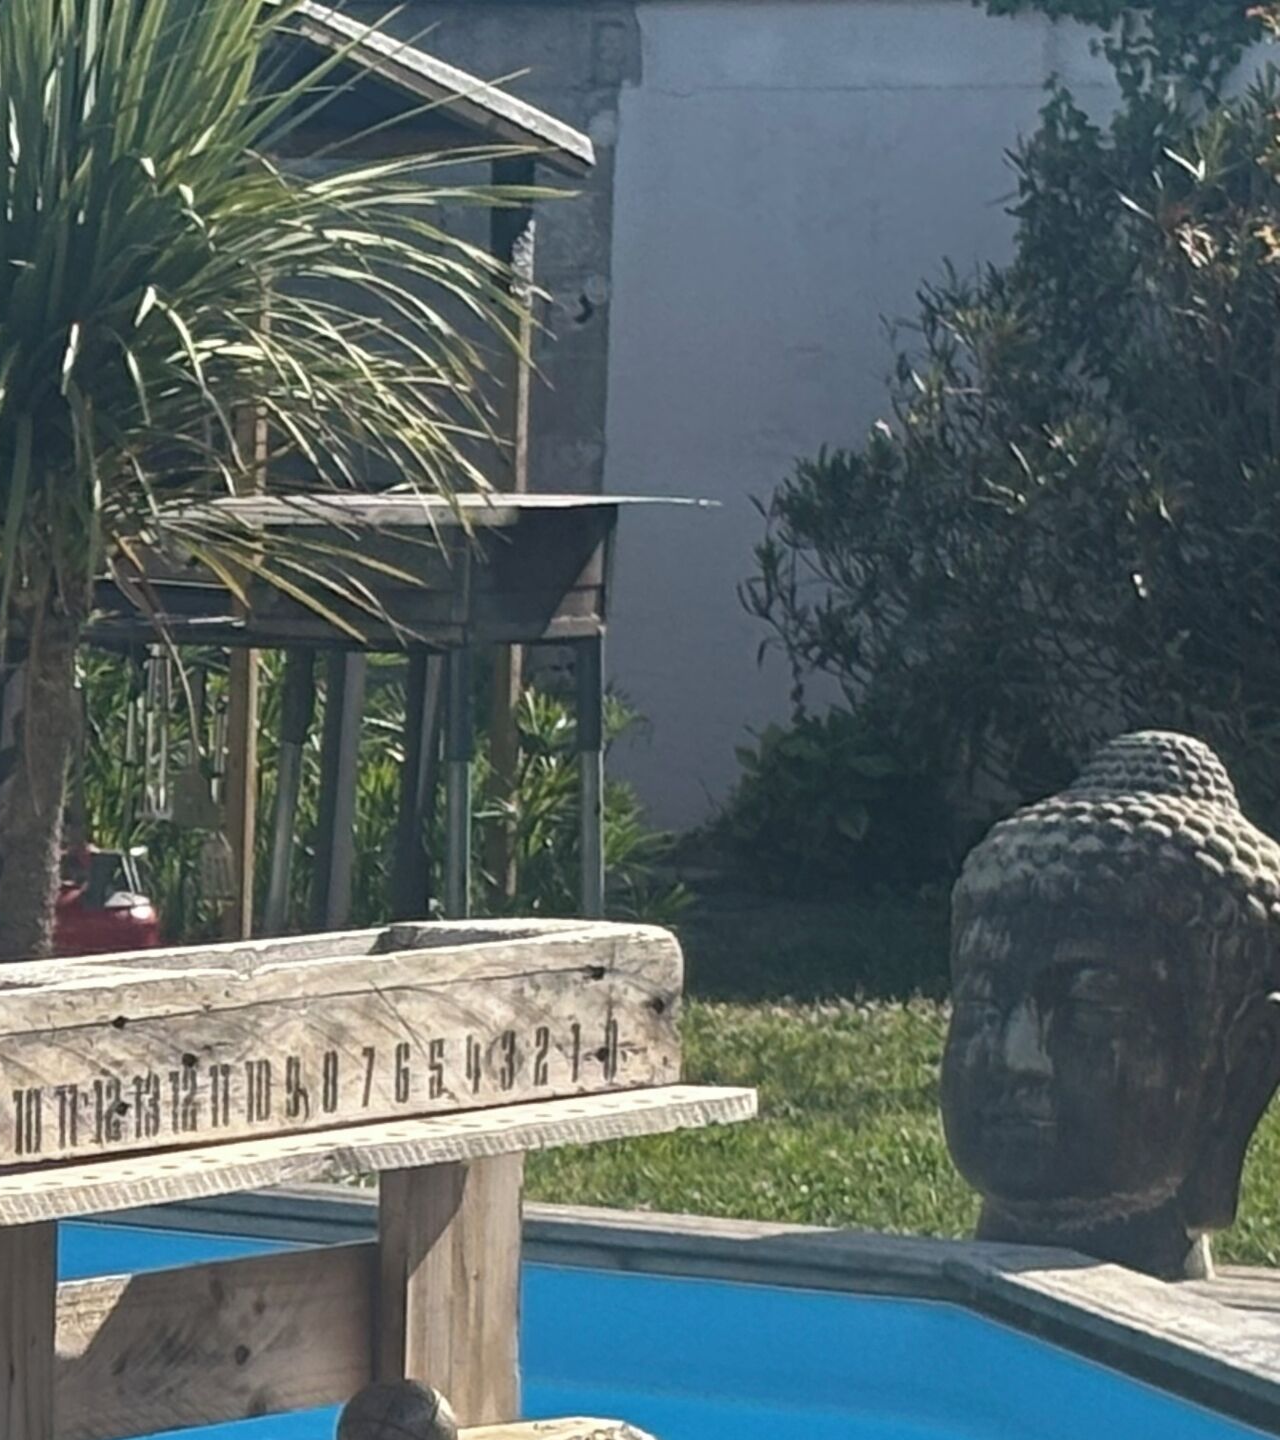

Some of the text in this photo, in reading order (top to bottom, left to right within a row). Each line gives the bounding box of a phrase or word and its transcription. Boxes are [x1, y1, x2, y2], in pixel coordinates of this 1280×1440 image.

[12, 1088, 41, 1155] 10
[93, 1078, 122, 1144] 12
[131, 1070, 161, 1139] 13
[209, 1063, 231, 1128] 11
[244, 1059, 271, 1123] 10
[361, 1046, 376, 1109] 7
[394, 1041, 411, 1104] 6
[428, 1037, 446, 1100] 5
[465, 1034, 482, 1095] 4
[499, 1029, 517, 1091] 3
[533, 1025, 551, 1087] 2
[570, 1022, 582, 1083] 1
